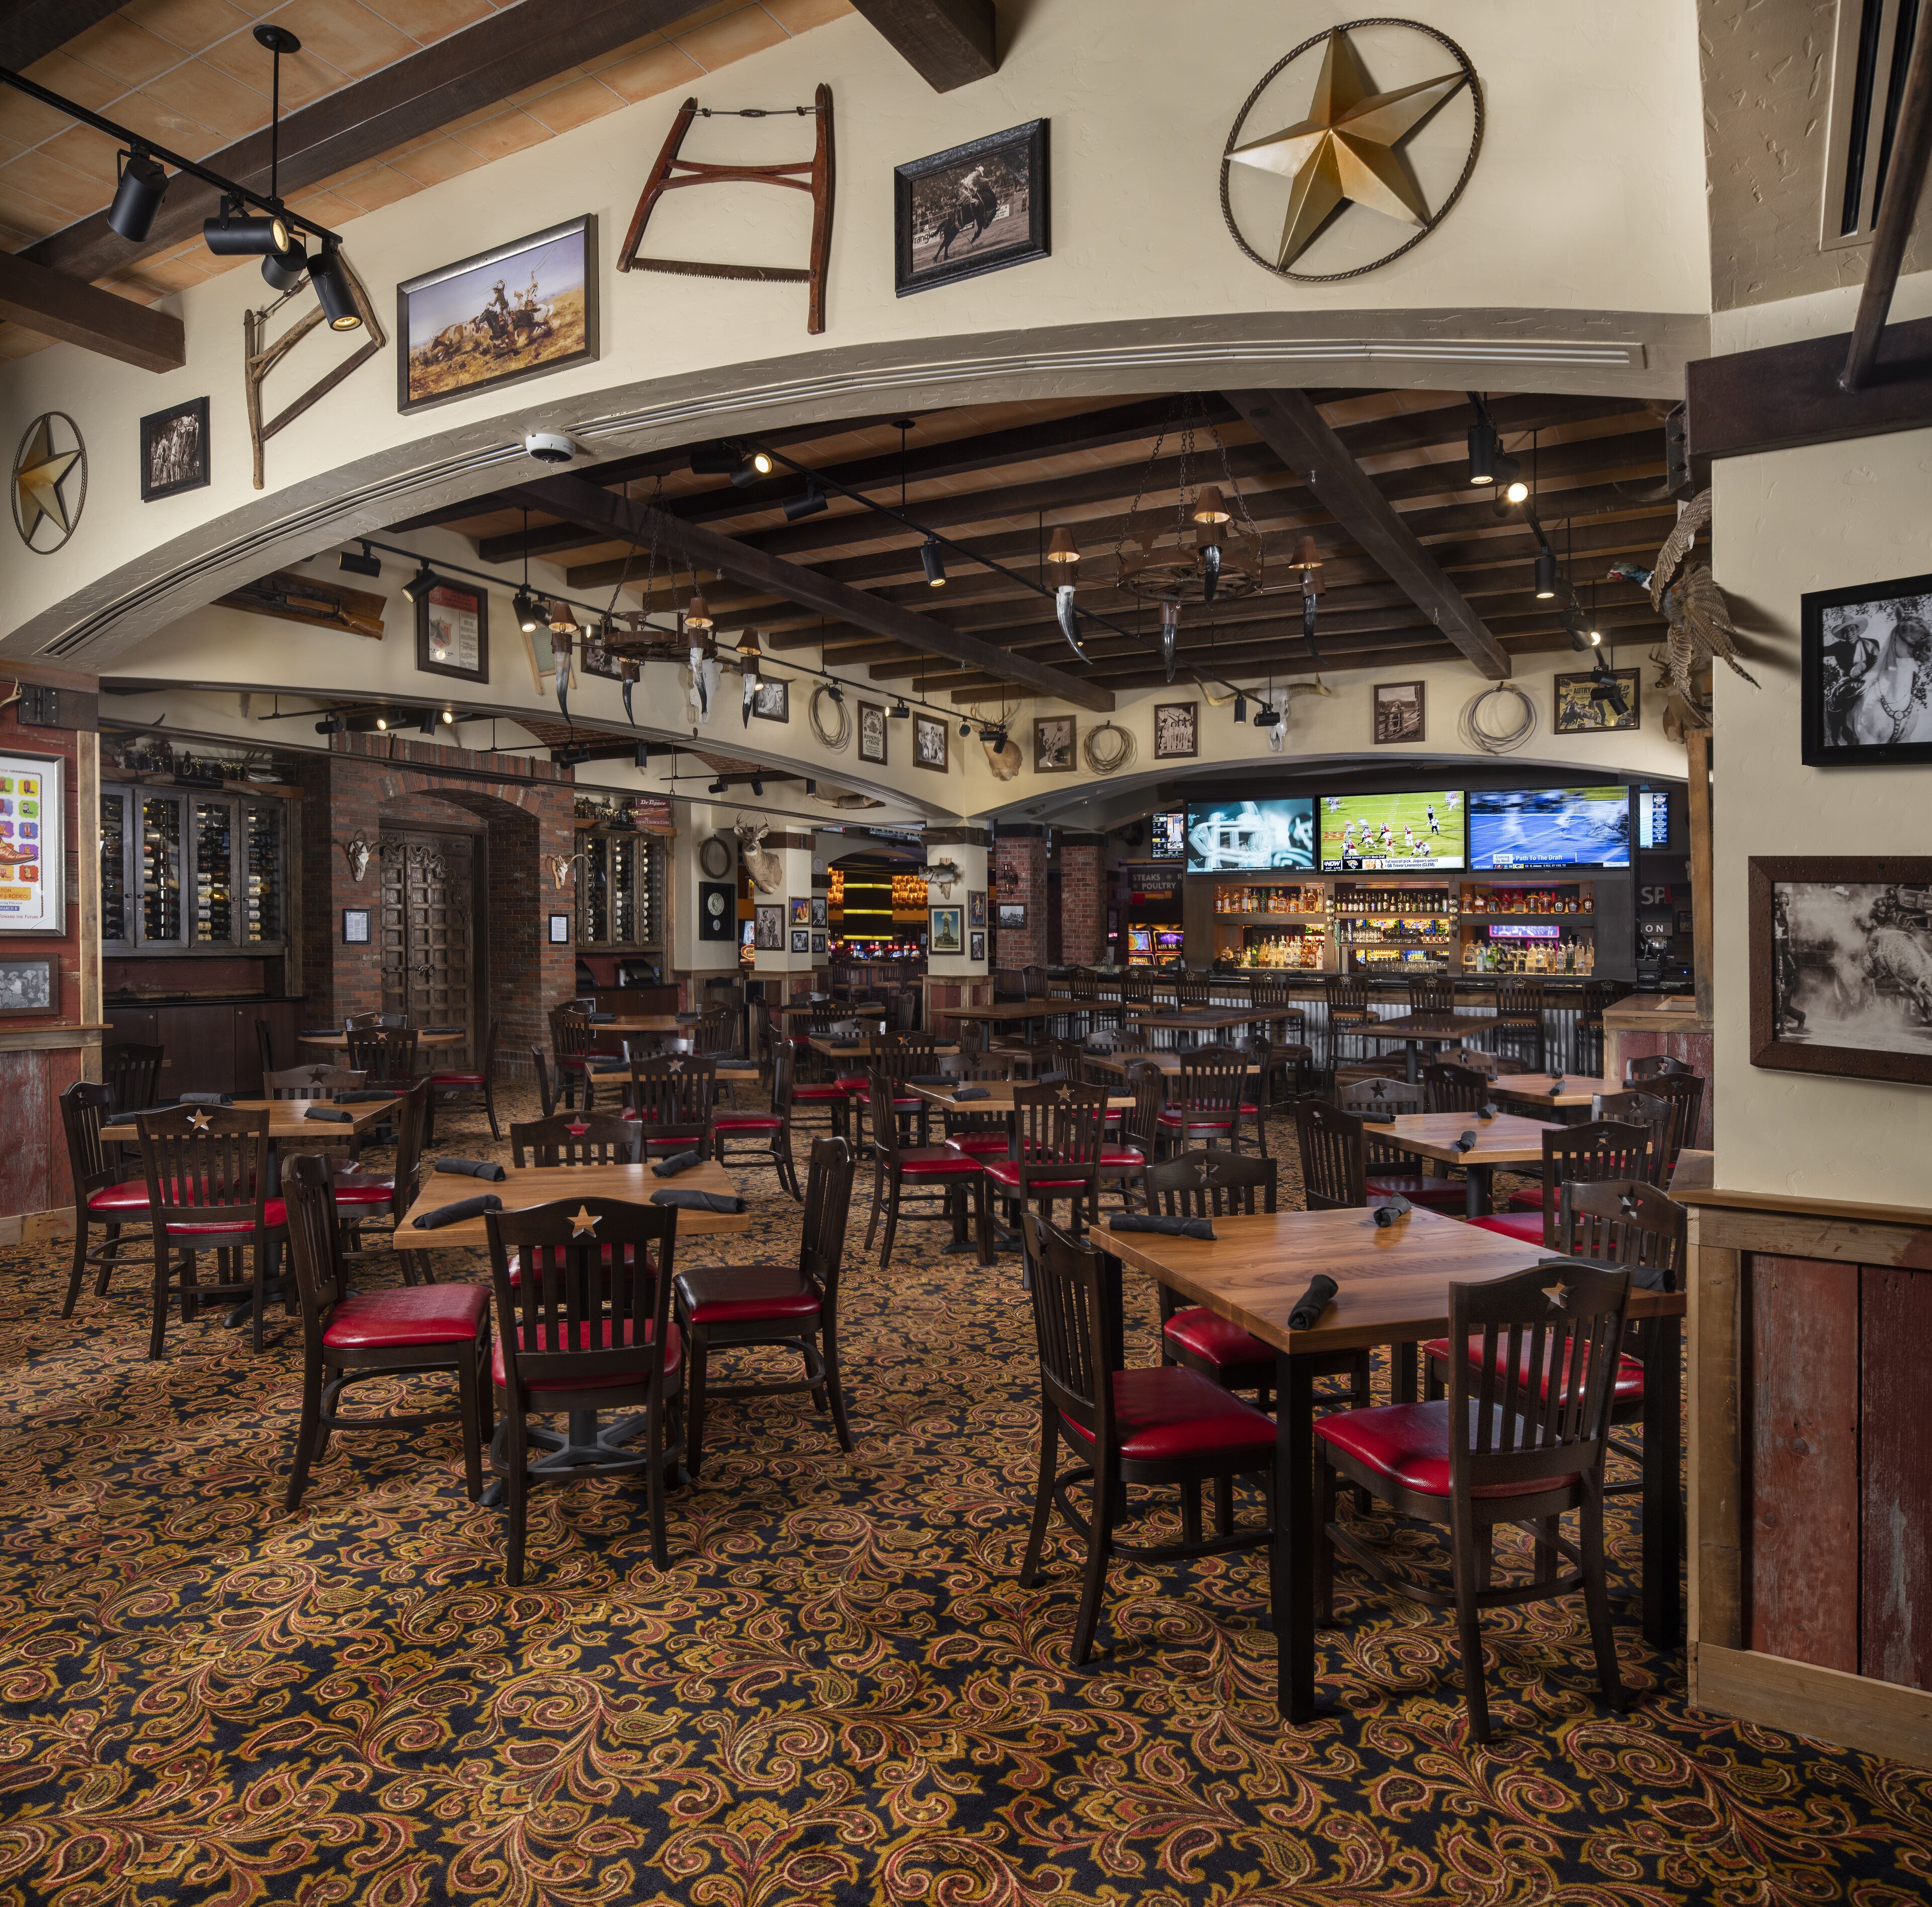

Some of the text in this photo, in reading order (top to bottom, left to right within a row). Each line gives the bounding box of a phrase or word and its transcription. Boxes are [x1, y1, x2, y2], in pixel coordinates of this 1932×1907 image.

[1133, 873, 1160, 881] STEAKS
[1142, 882, 1176, 890] POULTRY
[1117, 890, 1129, 899] EXIT
